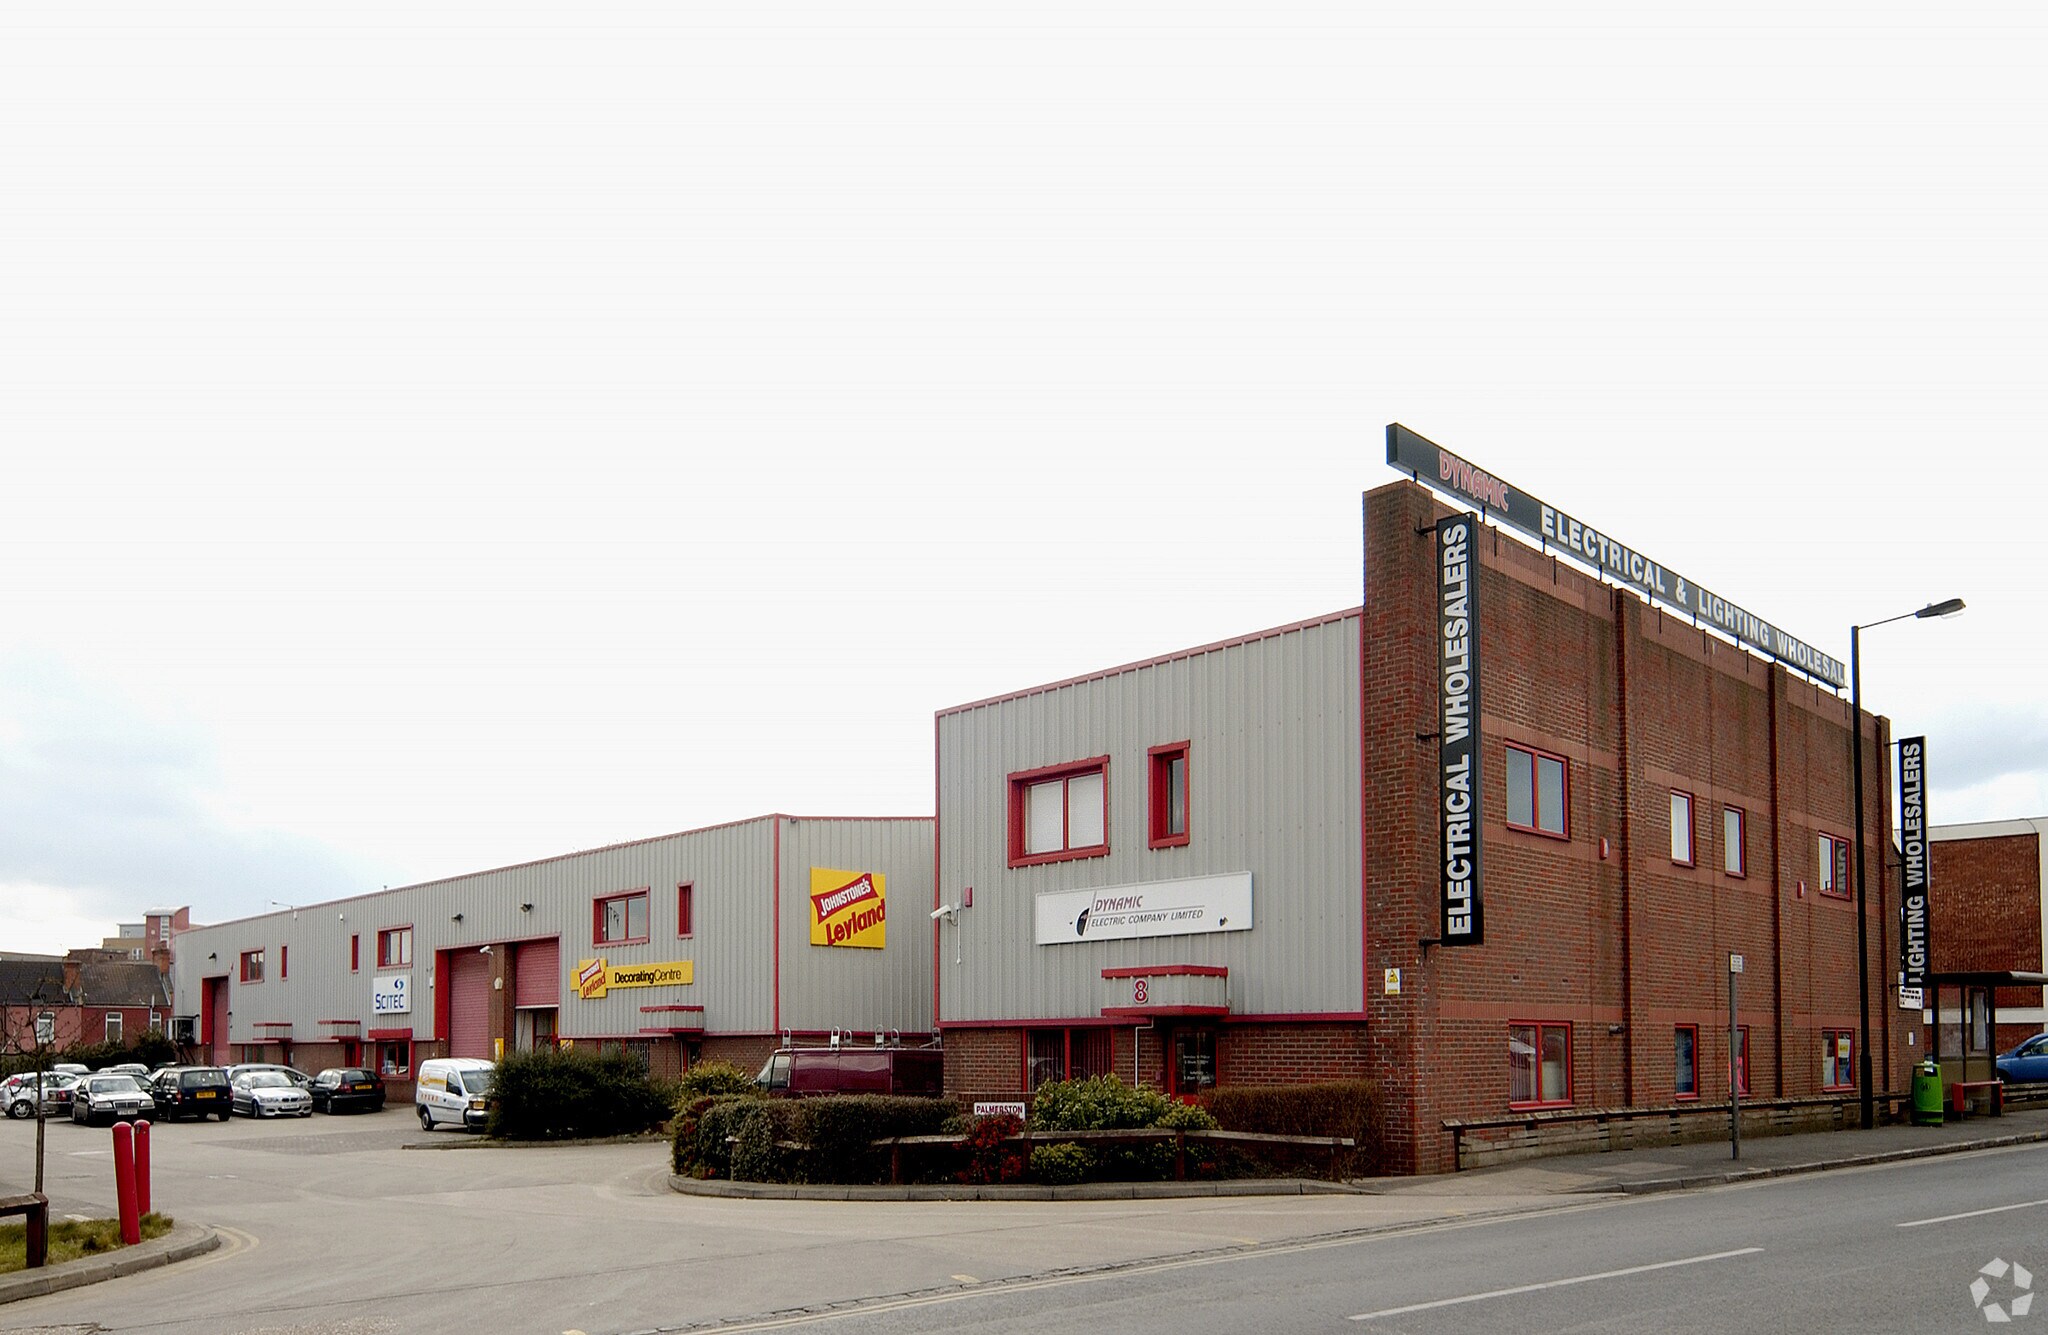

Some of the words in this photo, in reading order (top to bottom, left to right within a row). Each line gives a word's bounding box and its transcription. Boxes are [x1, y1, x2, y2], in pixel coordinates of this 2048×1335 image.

[1439, 449, 1509, 513] DYNAMIC
[1541, 504, 1666, 593] ELECTRICAL
[1675, 576, 1687, 605] &
[1698, 588, 1769, 648] LIGHTING
[1443, 523, 1471, 744] WHOLESALERS
[1903, 743, 1924, 888] WHOLESALERS
[1446, 754, 1472, 936] ELECTRICAL
[820, 878, 871, 916] JOHNSTONE'S
[1091, 915, 1126, 928] ELECTRIC
[1128, 911, 1169, 924] COMPANY
[1170, 909, 1204, 921] LIMITED
[1095, 895, 1144, 912] DYNAMIC
[825, 898, 886, 946] Leyland
[1906, 895, 1926, 983] LIGHTING
[1134, 978, 1148, 1003] 8
[976, 1105, 1023, 1114] PALMERSTON
